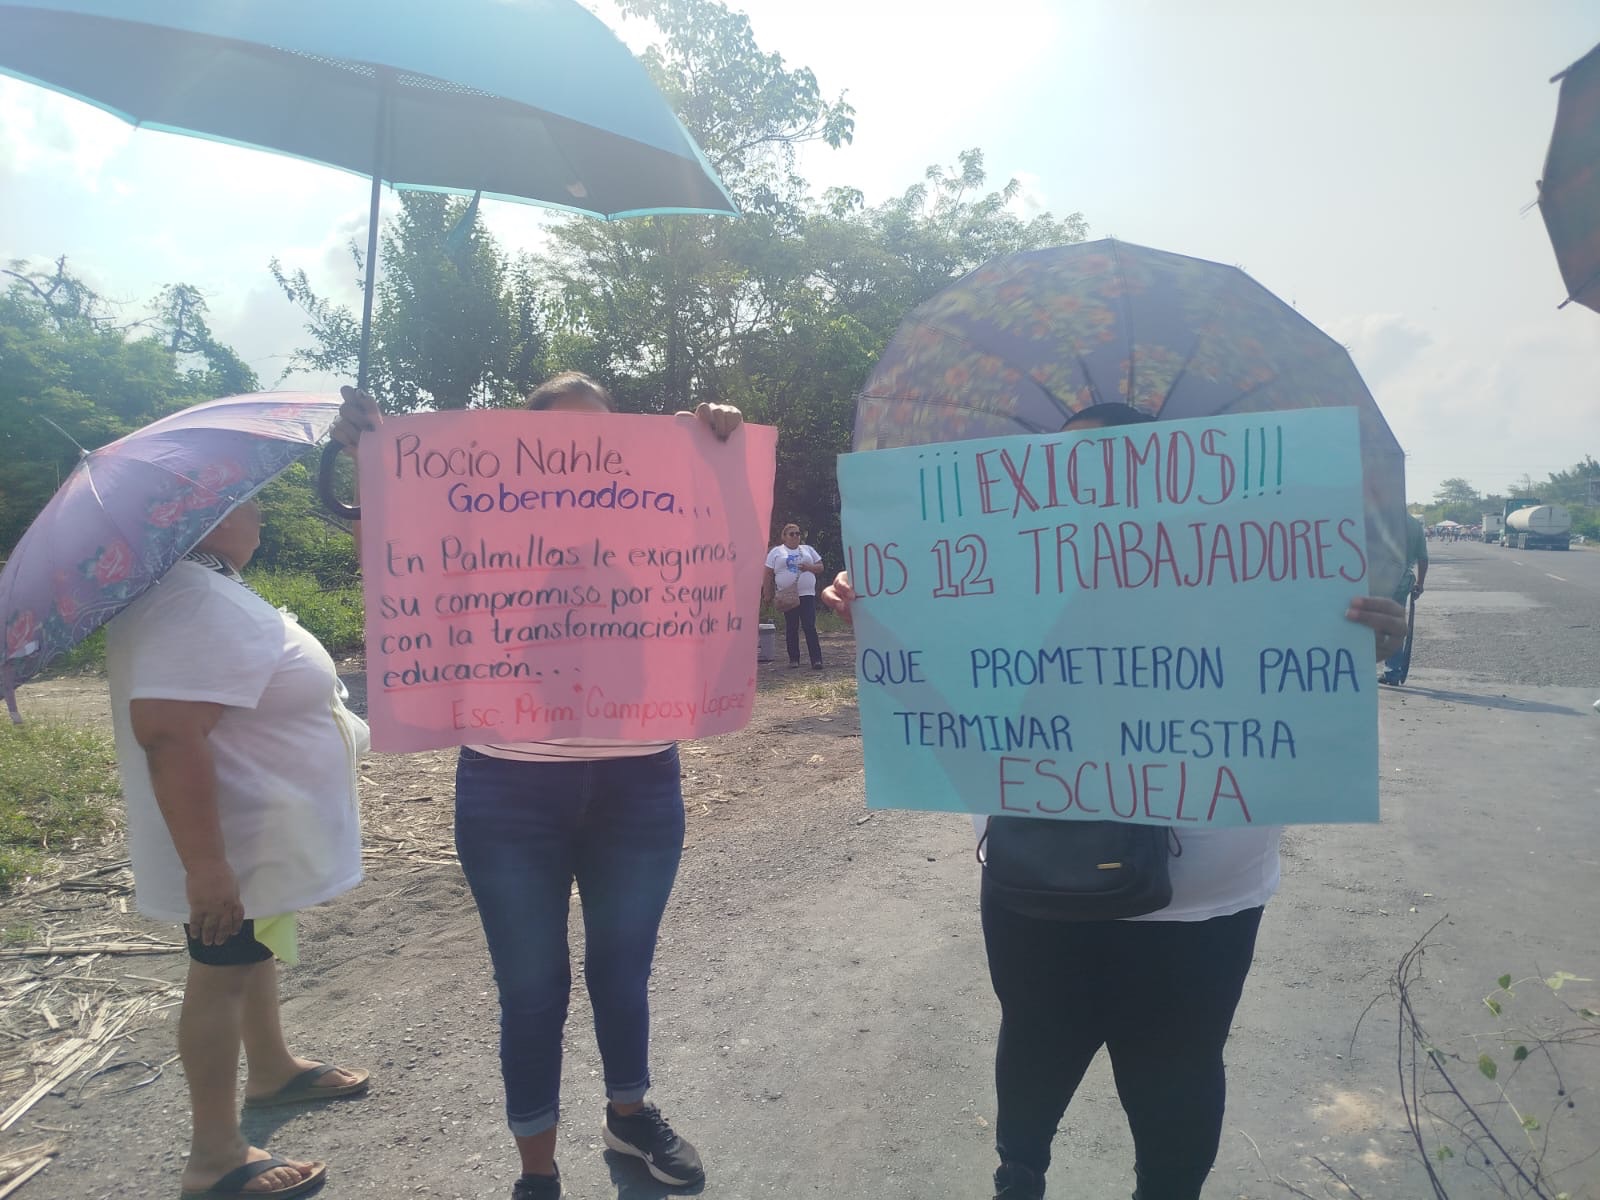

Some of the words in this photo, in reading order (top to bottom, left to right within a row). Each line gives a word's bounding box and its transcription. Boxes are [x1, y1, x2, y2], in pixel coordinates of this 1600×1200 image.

[516, 437, 631, 476] Nahle.
[387, 539, 424, 577] En
[441, 534, 580, 572] Palmillas
[594, 538, 616, 568] le
[628, 542, 737, 583] exigimos
[848, 542, 908, 599] LOS
[931, 534, 994, 598] 12
[1018, 519, 1367, 595] TRABAJADORES
[380, 595, 421, 619] su
[435, 585, 600, 618] compromiso
[611, 585, 653, 615] por
[661, 584, 728, 618] seguir
[381, 632, 432, 654] con
[449, 625, 473, 647] la
[491, 609, 693, 644] transformación
[699, 612, 719, 635] de
[728, 611, 743, 632] la
[862, 648, 926, 686] QUE
[971, 646, 1224, 689] PROMETIERON
[1260, 647, 1360, 694] PARA
[893, 711, 1073, 752] TERMINAR
[1121, 719, 1296, 759] NUESTRA
[1000, 756, 1252, 823] ESCUELA
